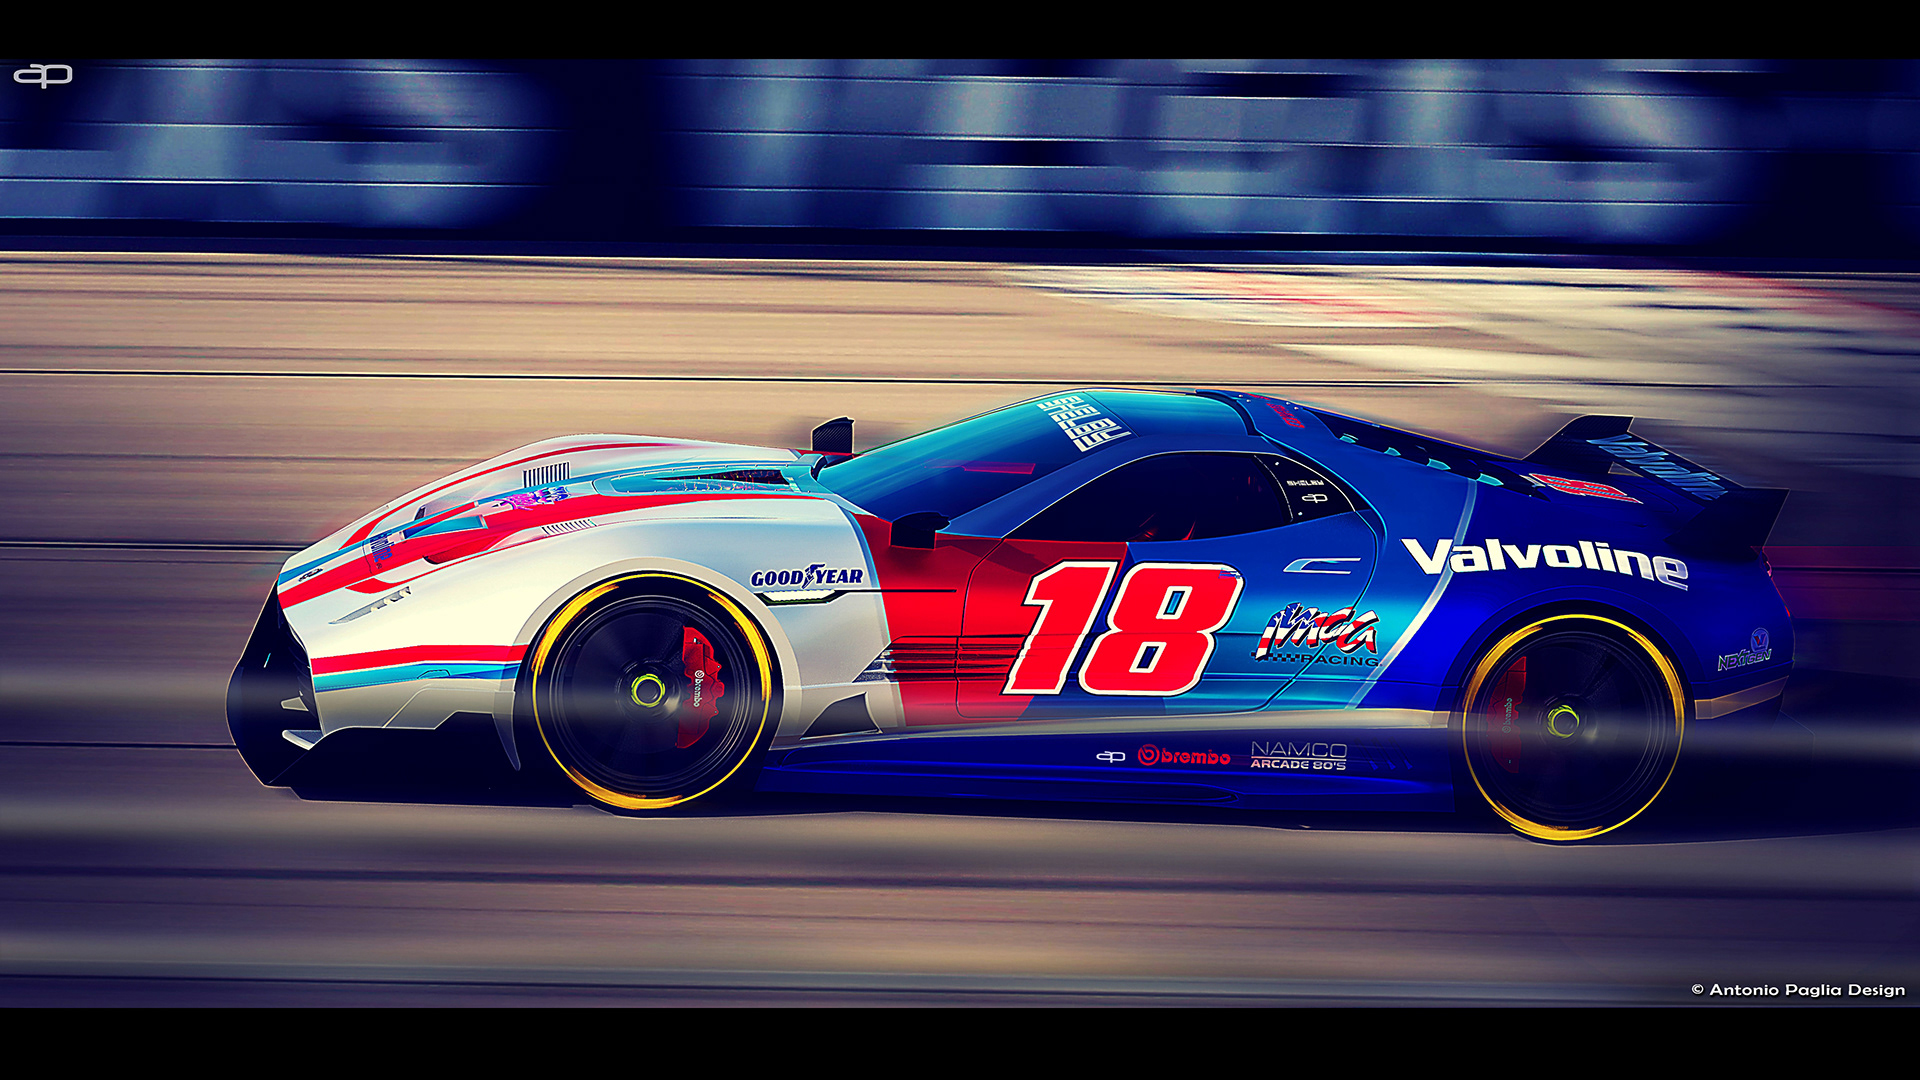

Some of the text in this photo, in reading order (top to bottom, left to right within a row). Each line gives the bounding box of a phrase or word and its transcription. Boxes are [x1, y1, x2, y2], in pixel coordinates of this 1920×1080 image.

[1400, 537, 1689, 592] Valvoline
[999, 558, 1246, 698] 18
[693, 678, 704, 708] brembo
[1161, 748, 1232, 766] brembo
[1250, 740, 1348, 759] NAMCO
[1250, 758, 1309, 770] ARCADE
